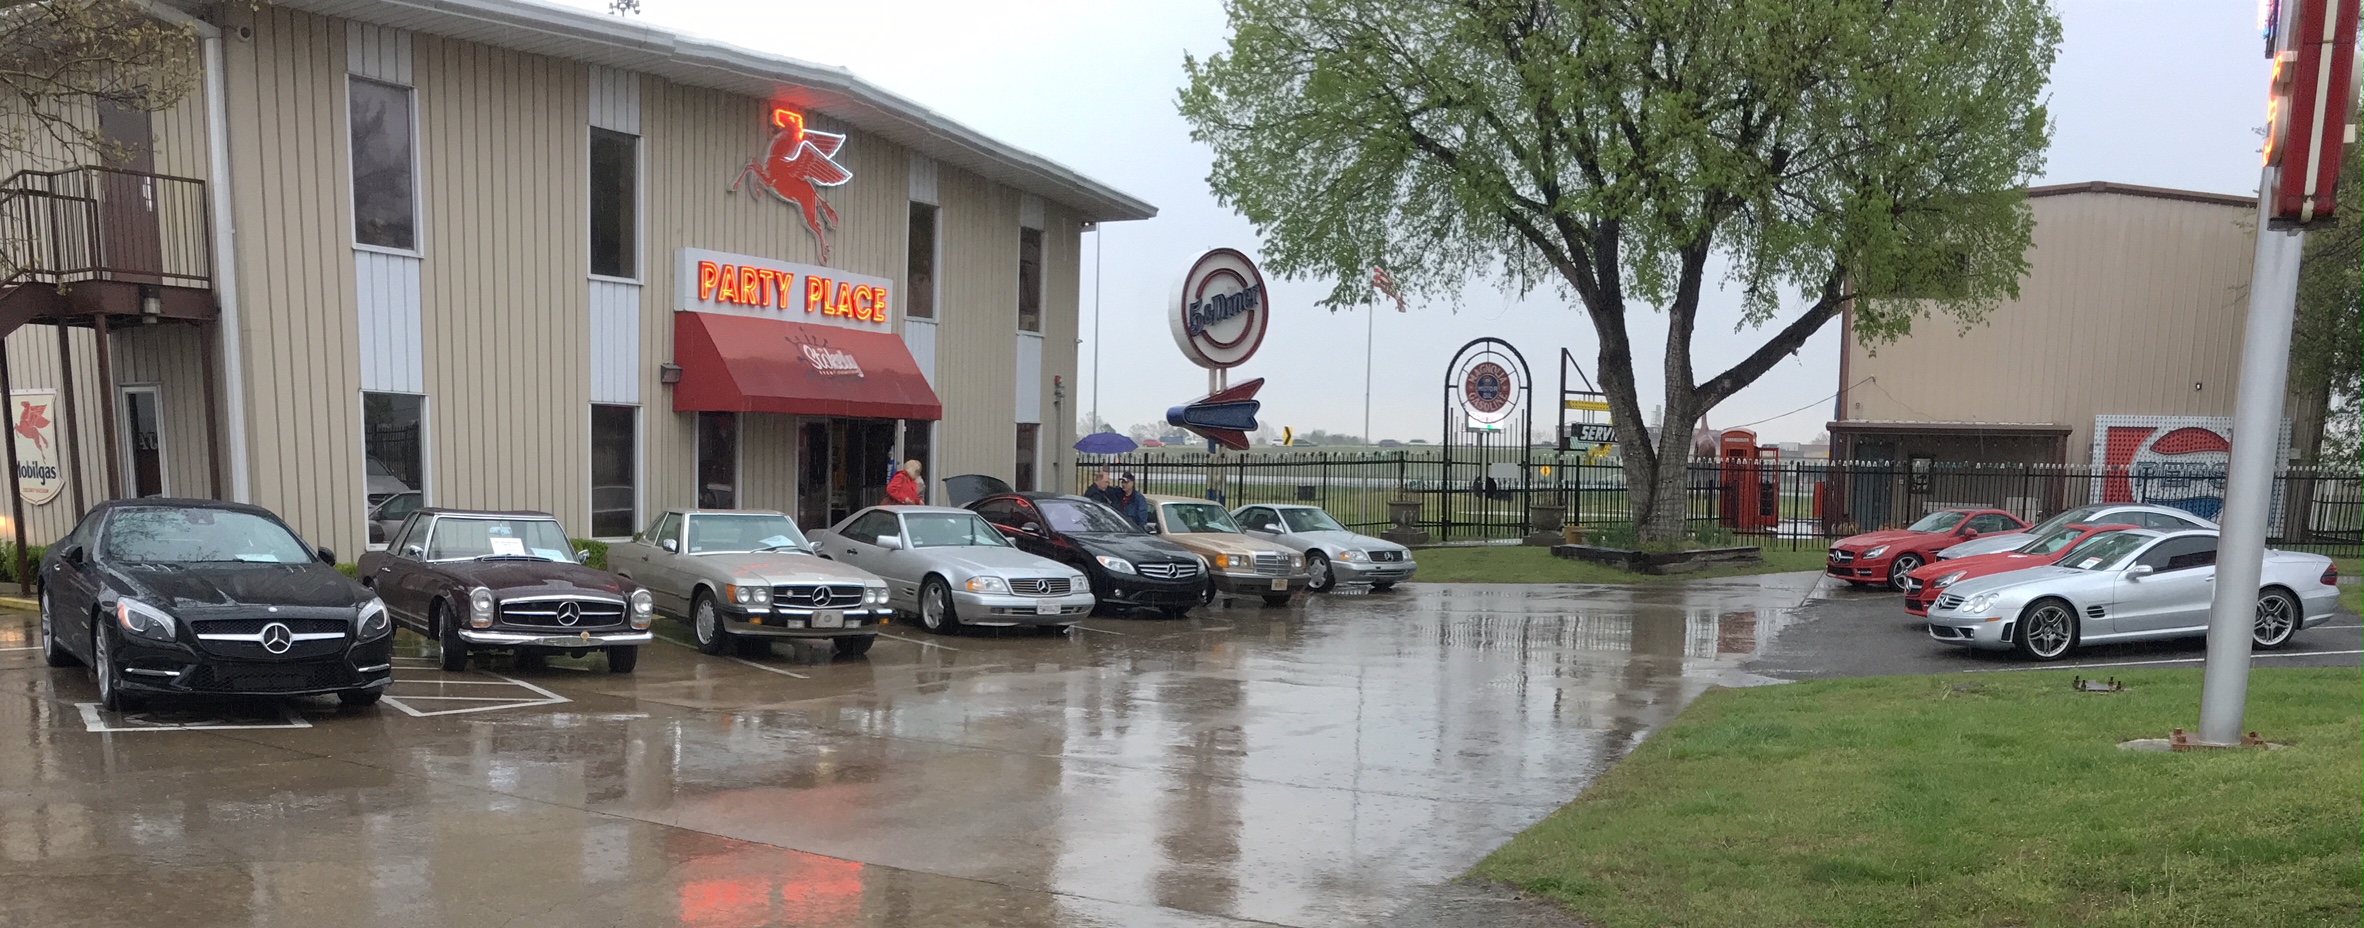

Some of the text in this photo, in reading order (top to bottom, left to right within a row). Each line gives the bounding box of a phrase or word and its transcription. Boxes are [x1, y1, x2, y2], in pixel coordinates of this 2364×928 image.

[698, 260, 887, 324] PARTY PLACE
[1469, 364, 1508, 384] MAGNOLIA
[1469, 392, 1508, 411] GASOLINE
